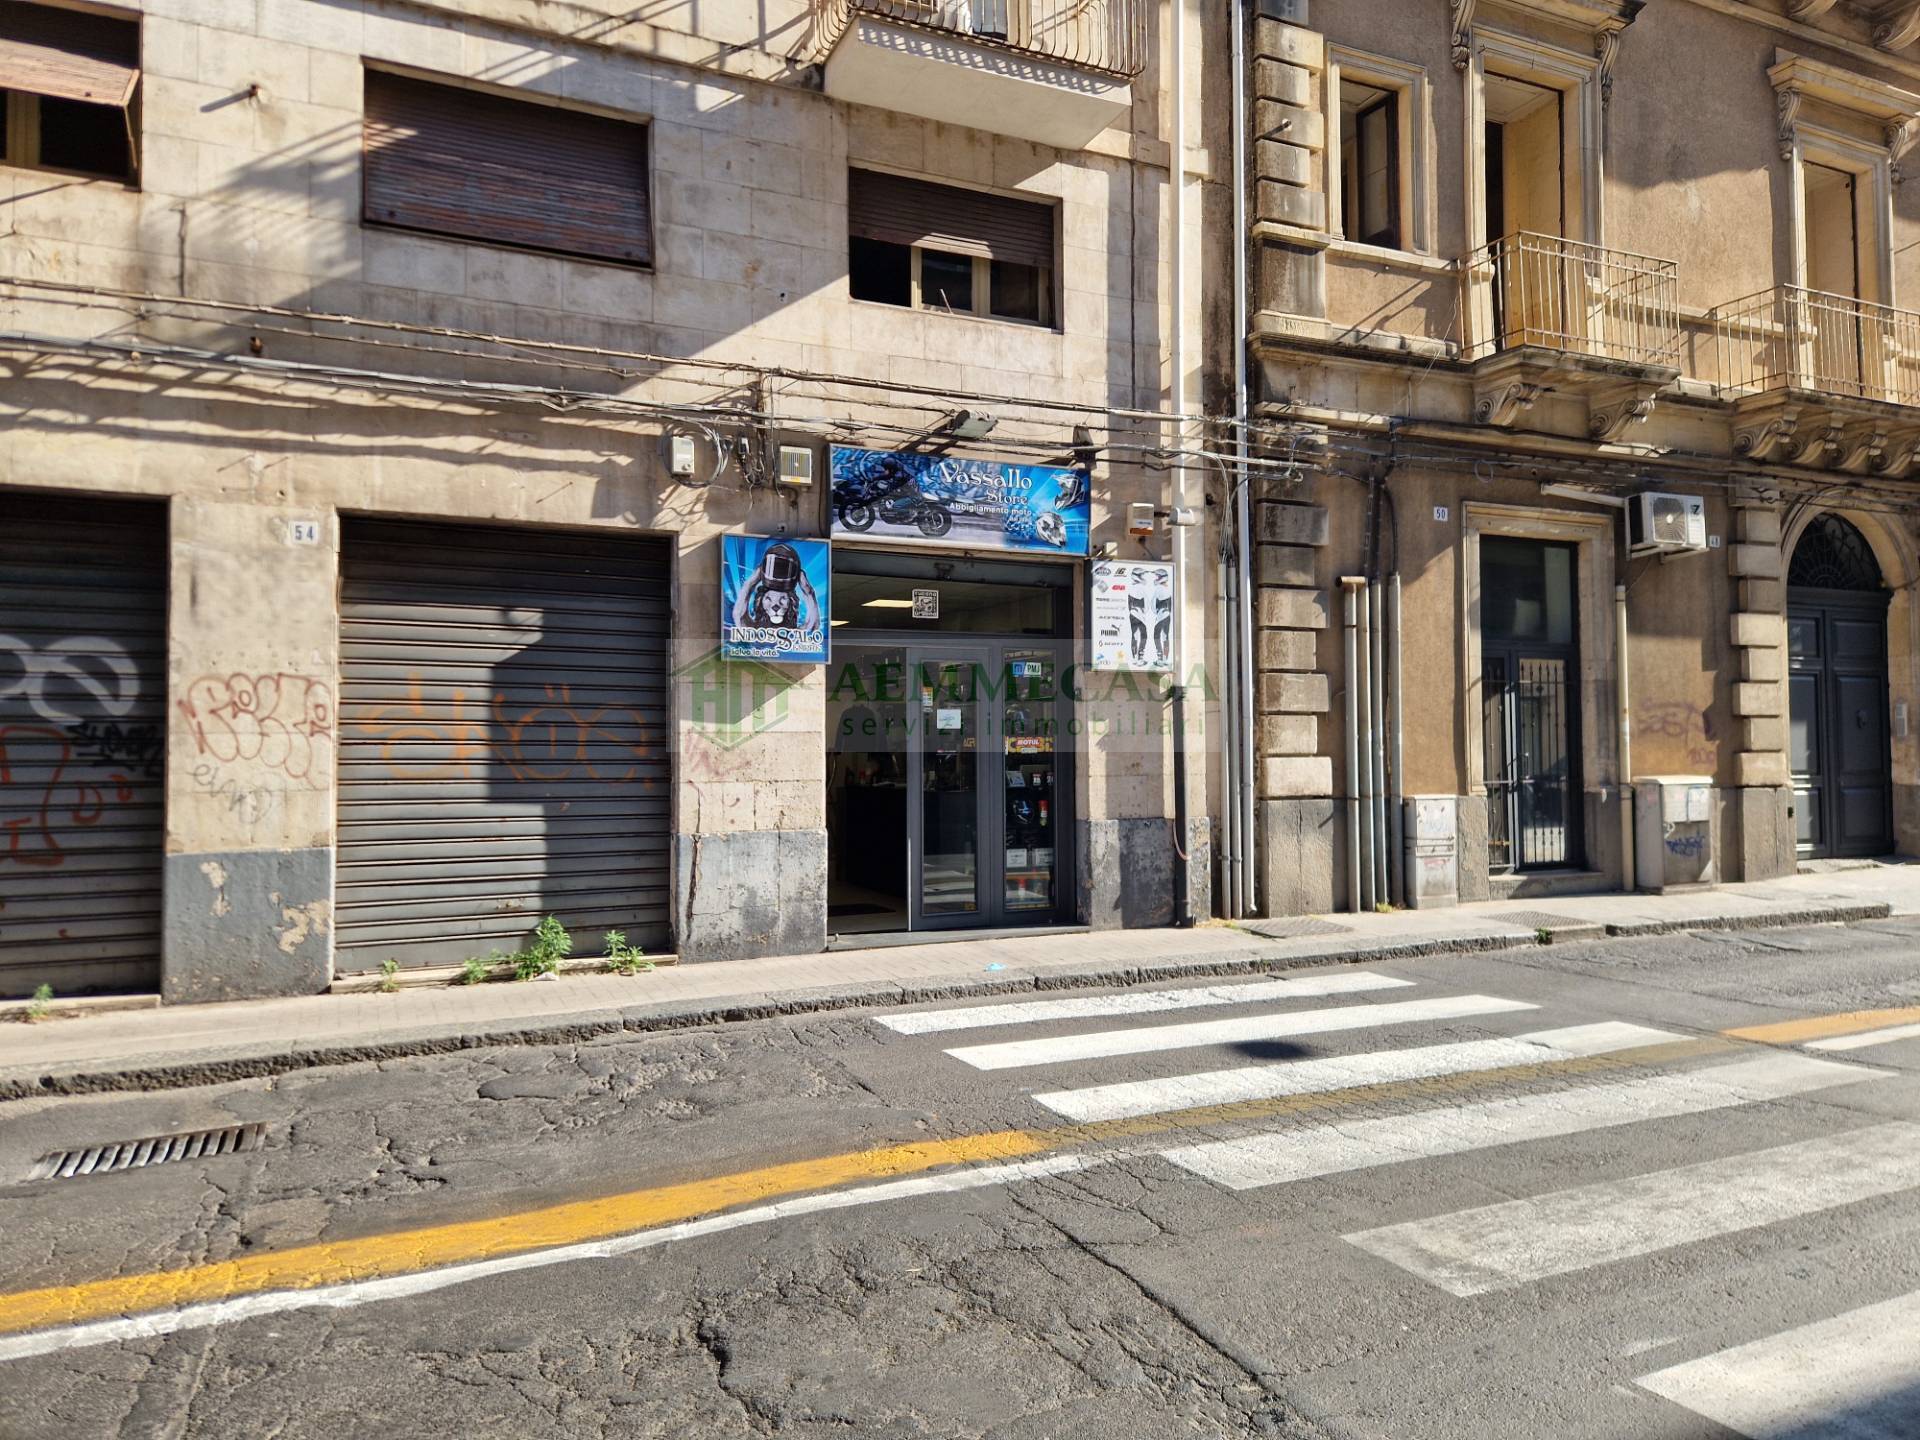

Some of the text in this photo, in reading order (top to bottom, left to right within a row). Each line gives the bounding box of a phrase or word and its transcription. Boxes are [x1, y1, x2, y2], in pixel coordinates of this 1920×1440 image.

[940, 463, 1032, 489] Vassallo
[986, 489, 1028, 505] Store
[950, 502, 1032, 516] Abbigliamento moto
[1436, 508, 1446, 519] 50
[295, 525, 313, 541] 54
[1027, 664, 1040, 673] PMJ
[1017, 739, 1040, 747] MOTUL
